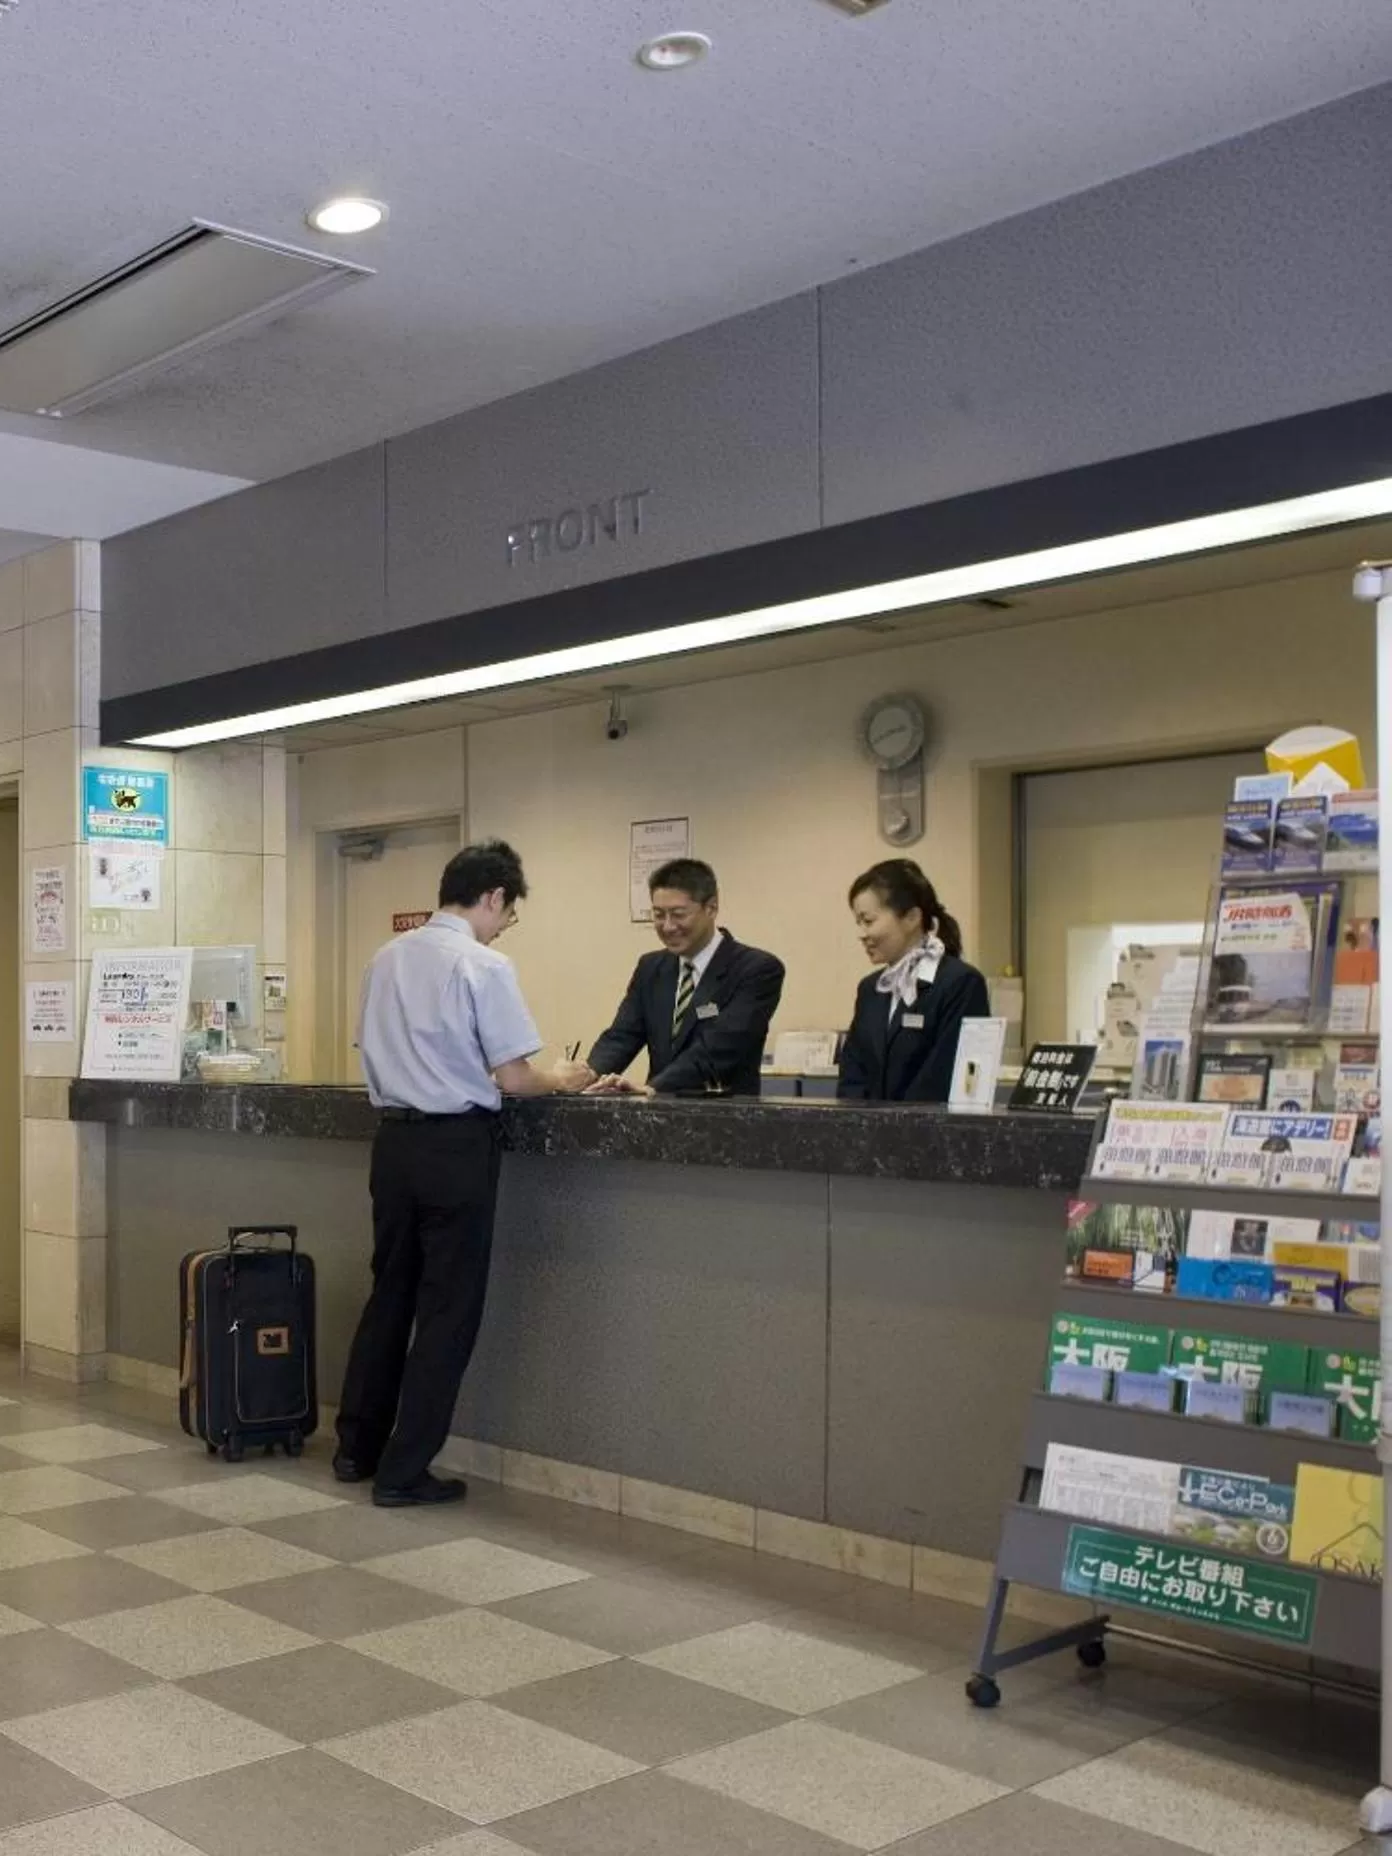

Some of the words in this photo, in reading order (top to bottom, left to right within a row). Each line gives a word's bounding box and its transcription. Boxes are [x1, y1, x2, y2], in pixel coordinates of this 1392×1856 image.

[507, 488, 654, 567] FRONT
[1324, 1374, 1381, 1430] 大
[1079, 1556, 1300, 1622] ご自由にお取り下さい
[1134, 1545, 1245, 1589] テレビ番組
